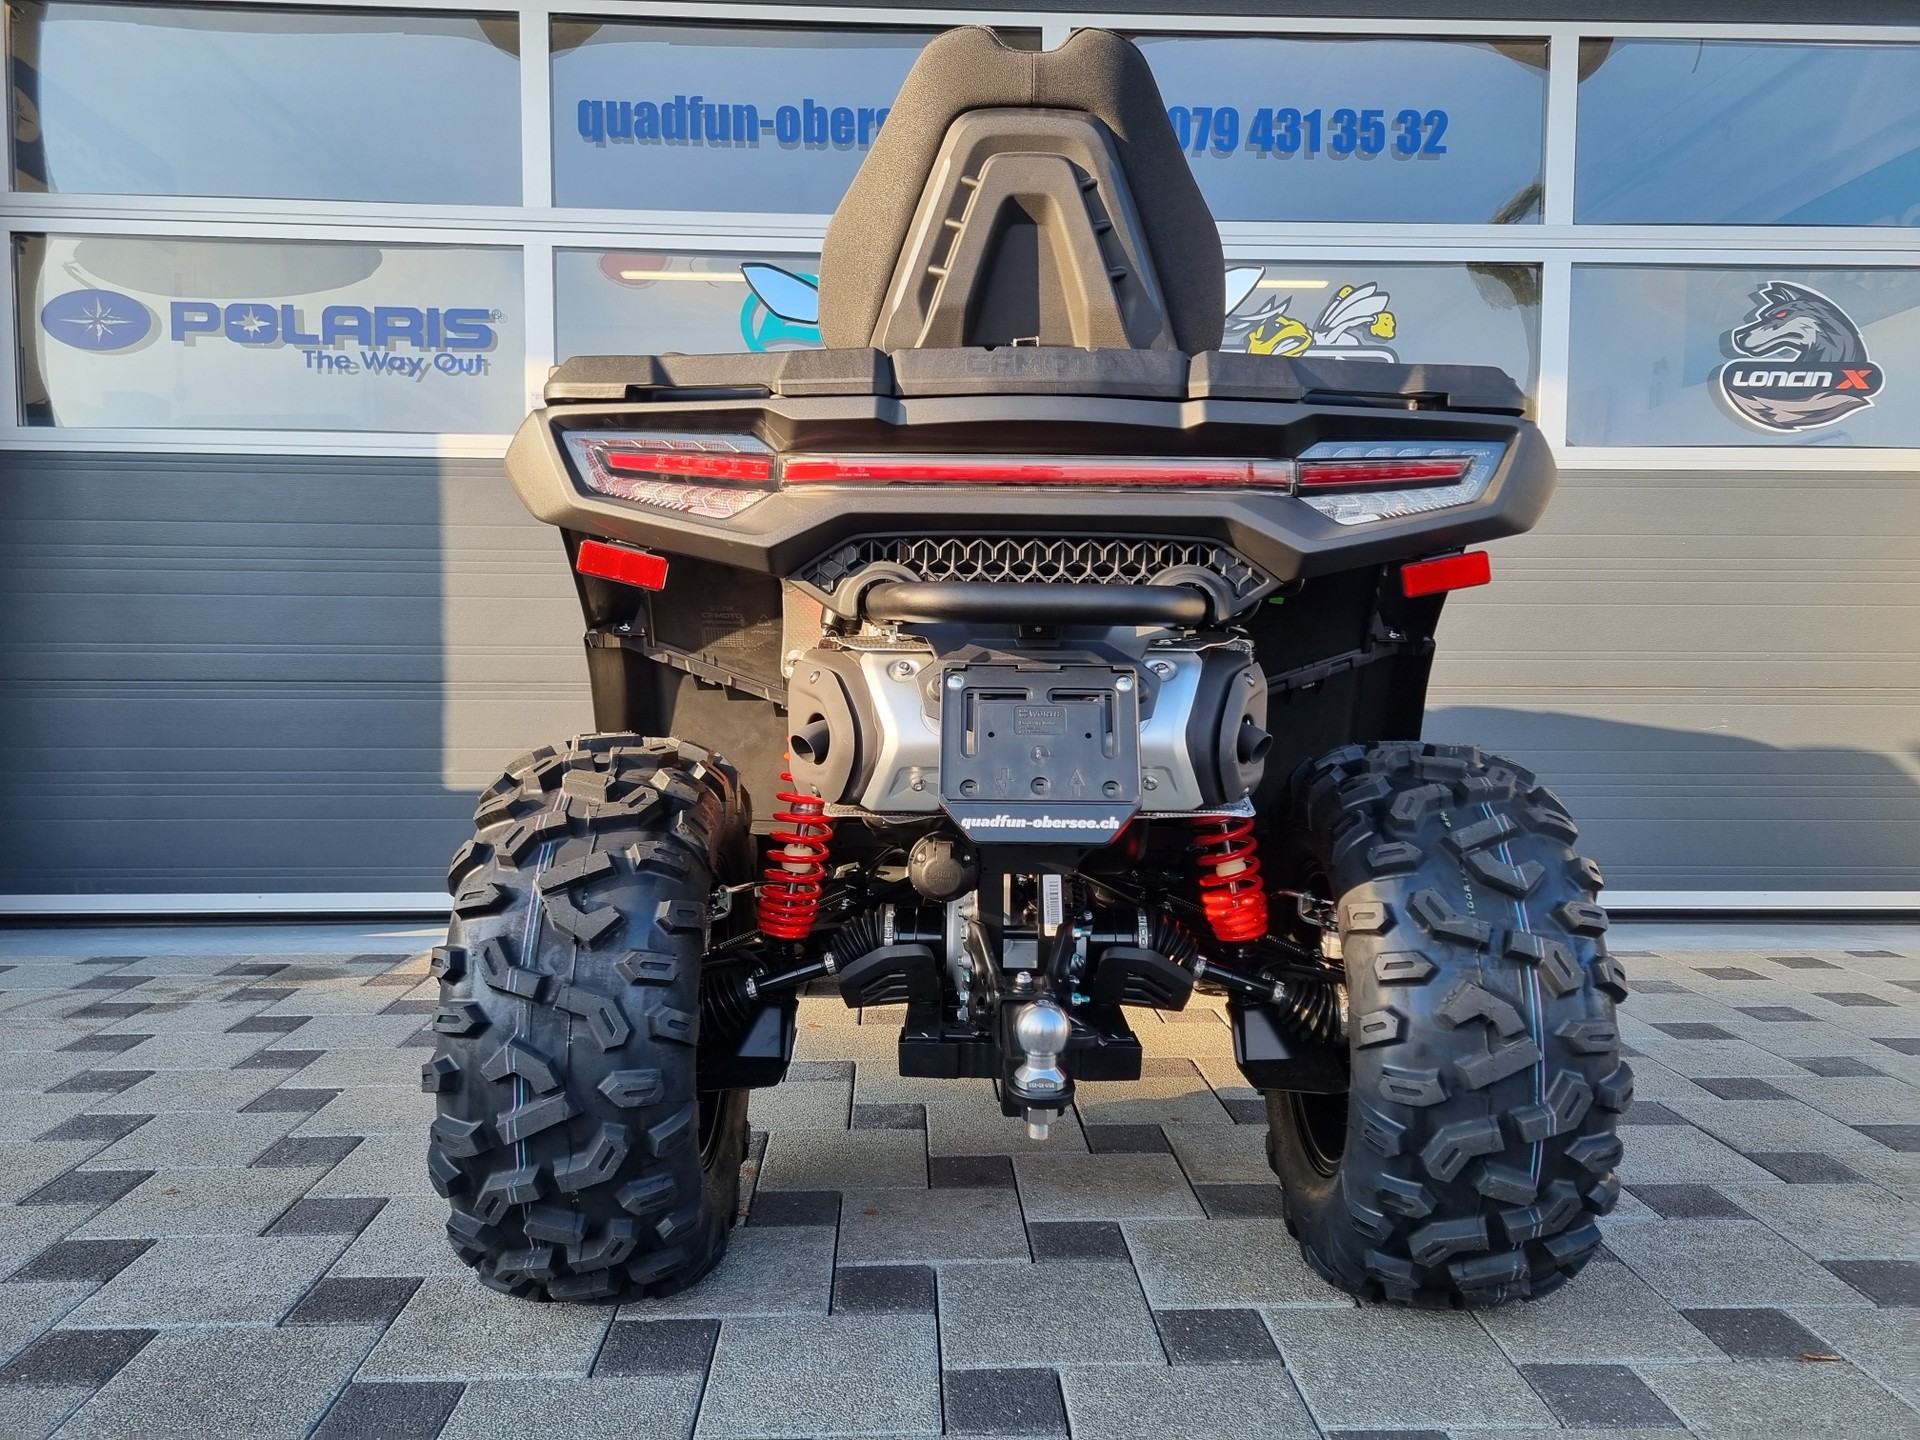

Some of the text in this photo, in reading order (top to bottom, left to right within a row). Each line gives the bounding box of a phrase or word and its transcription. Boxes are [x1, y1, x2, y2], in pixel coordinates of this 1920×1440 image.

[1168, 106, 1449, 155] 079 431 35 32
[170, 301, 495, 348] POLARIS
[302, 350, 485, 377] The Way Out
[1732, 369, 1873, 389] LONCIN X
[961, 815, 1120, 830] quadfun-obersee.ch
